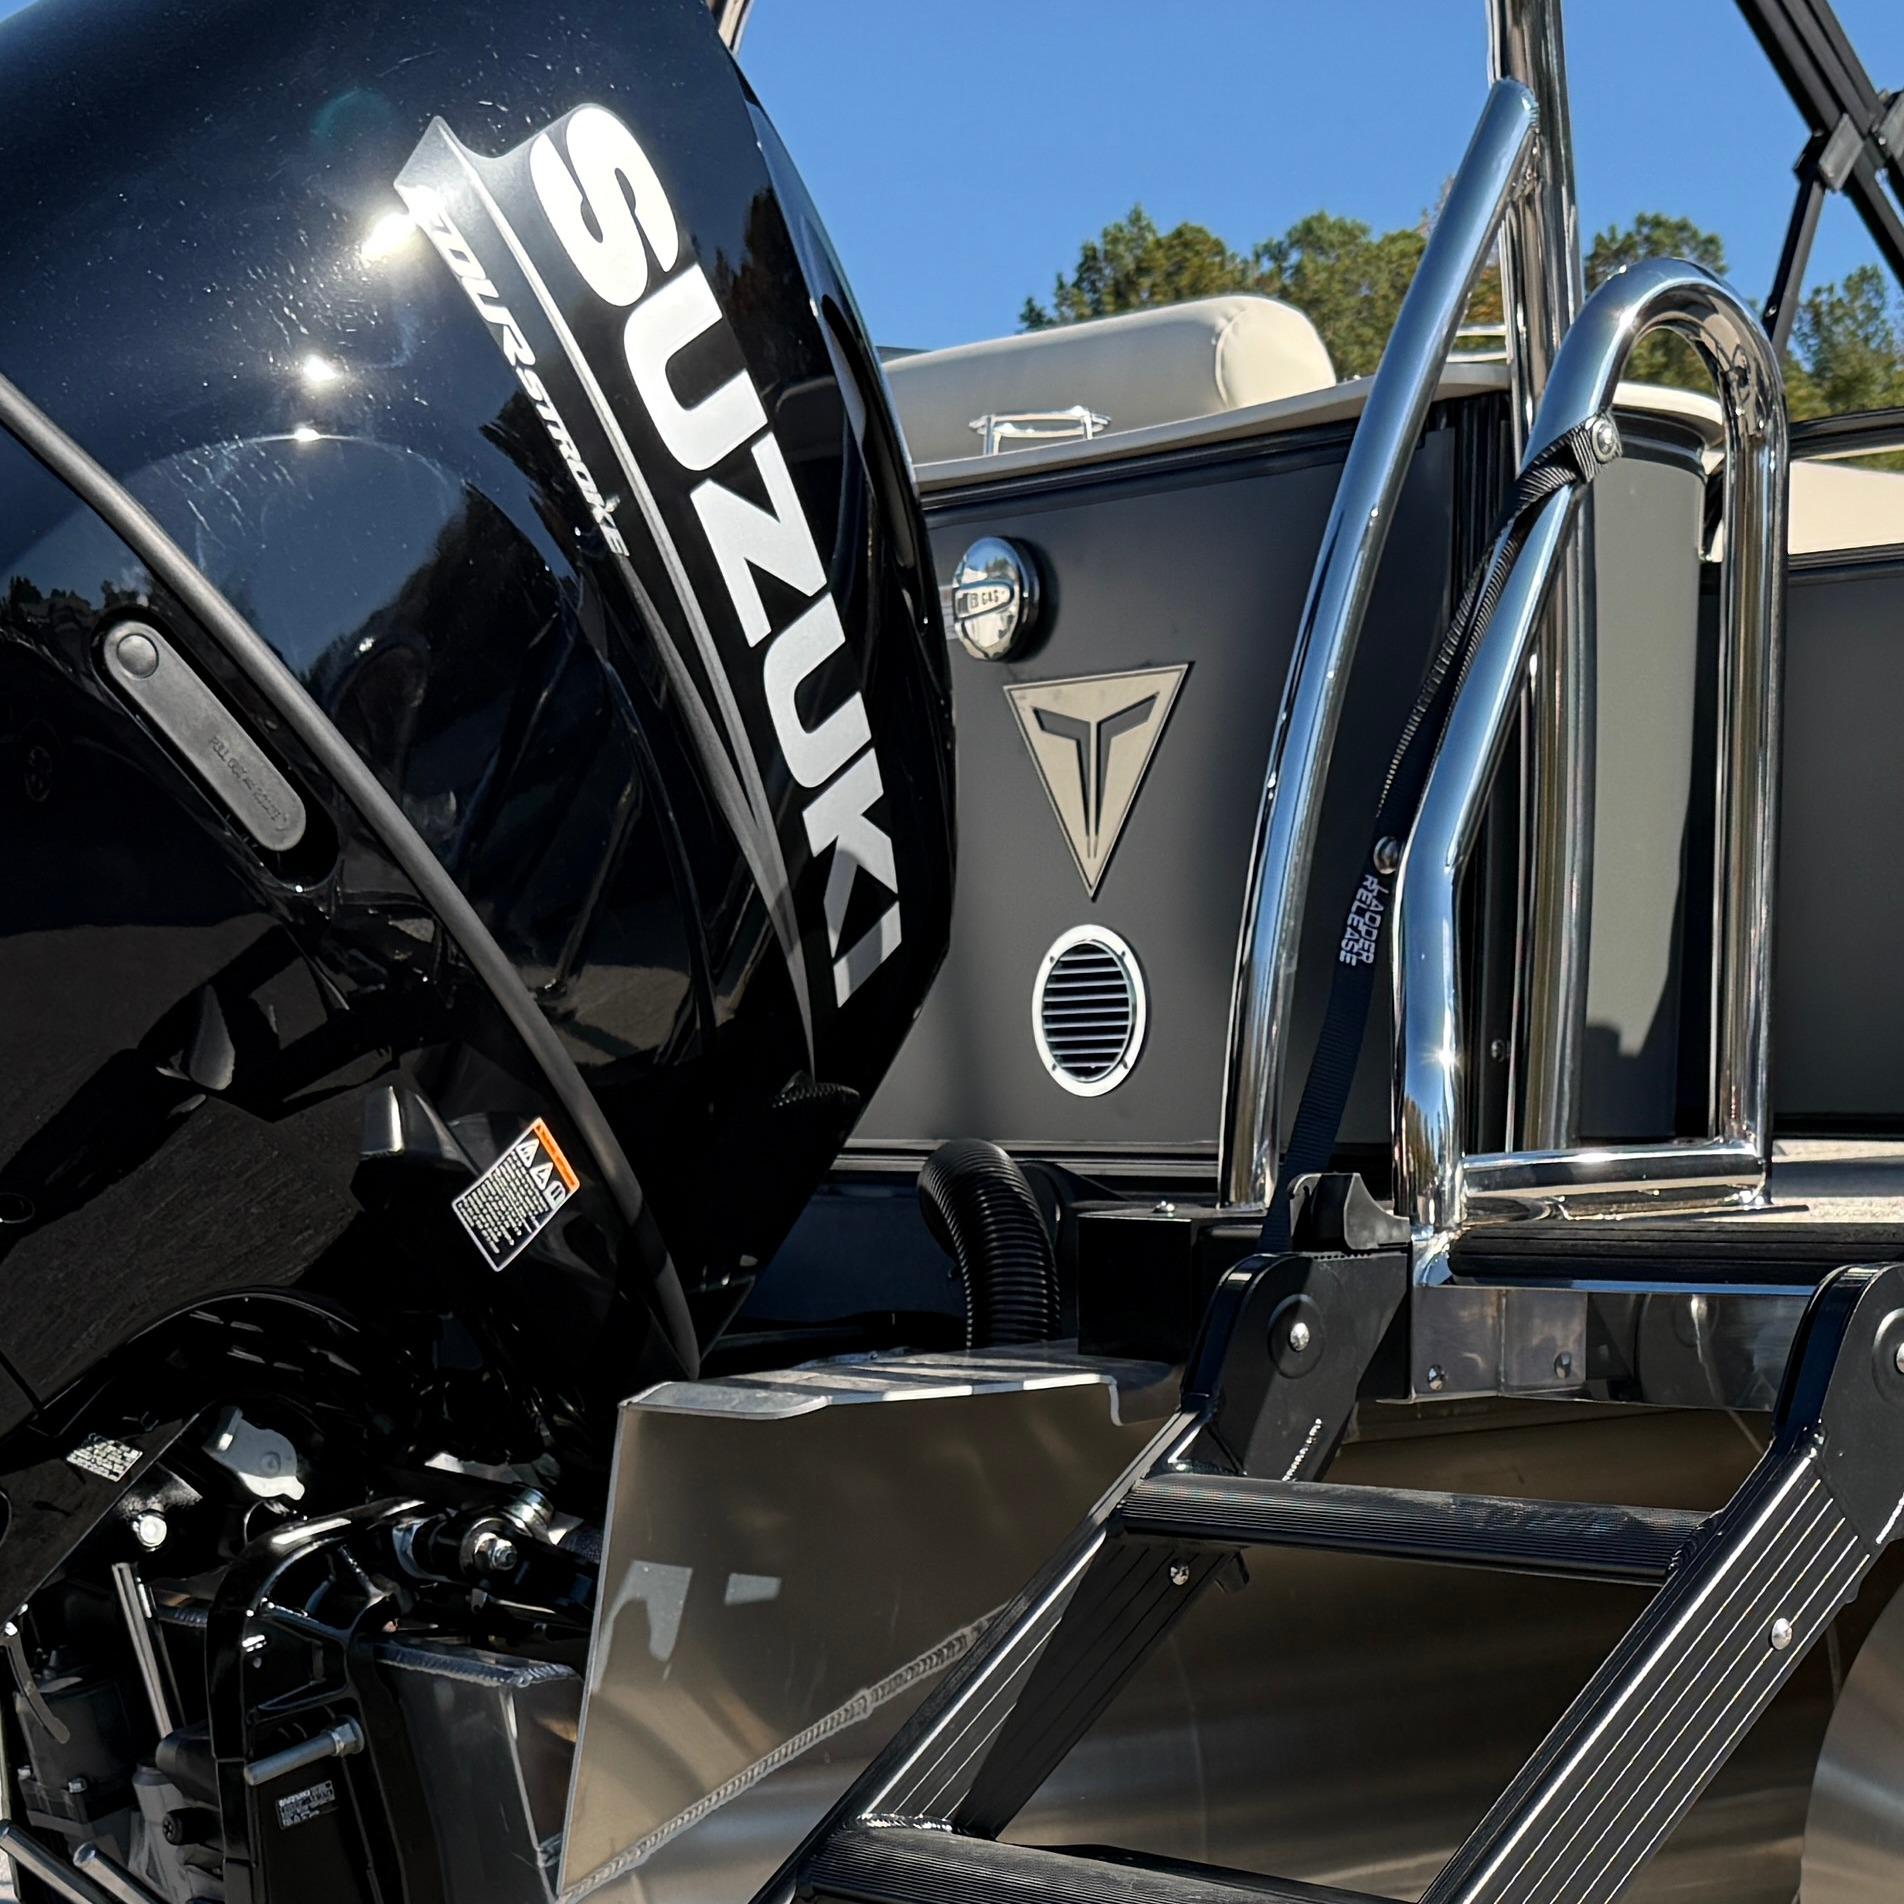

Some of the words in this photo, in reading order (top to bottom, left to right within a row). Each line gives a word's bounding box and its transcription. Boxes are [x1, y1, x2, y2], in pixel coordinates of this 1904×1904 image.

[530, 104, 902, 1009] SUZUKI
[1339, 874, 1378, 967] RELEASE
[1356, 884, 1390, 964] LADDER
